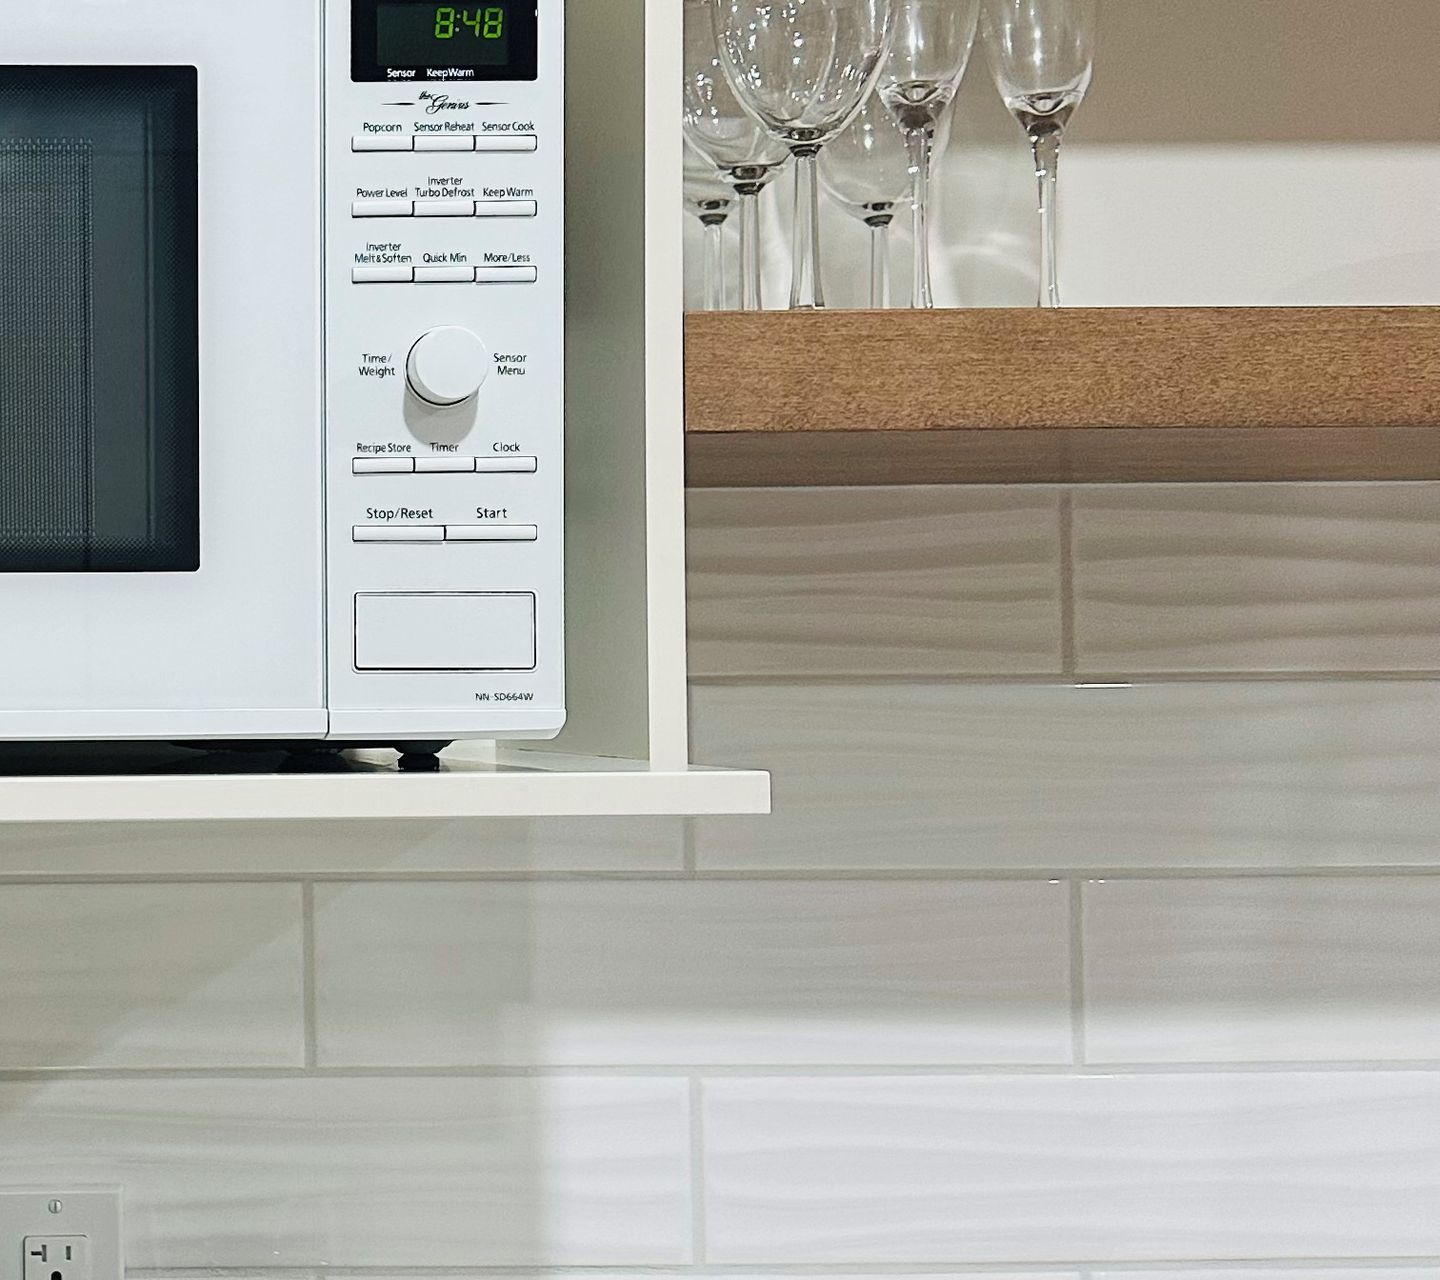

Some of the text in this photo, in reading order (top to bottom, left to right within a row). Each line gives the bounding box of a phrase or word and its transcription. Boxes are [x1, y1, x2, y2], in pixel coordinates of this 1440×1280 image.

[434, 7, 503, 39] 8:48
[387, 68, 416, 78] Sensor
[363, 122, 402, 134] Popcorn
[414, 121, 474, 132] Sensor Reheat
[482, 121, 535, 132] Sensor Cook
[428, 176, 463, 186] Inverter
[356, 187, 408, 198] Power Level
[415, 187, 475, 198] Turbo Defrost
[483, 187, 533, 199] Keep Warm
[366, 242, 401, 252] Inverter
[422, 252, 467, 263] Quick Min
[484, 252, 531, 263] More/Less
[493, 353, 527, 363] Sensor
[358, 366, 396, 378] Weight
[497, 366, 526, 375] Menu
[356, 442, 412, 454] Recipe Store
[429, 442, 459, 452] Timer
[492, 442, 520, 452] Clock
[366, 507, 433, 522] Stop/Reset
[476, 507, 507, 519] Start
